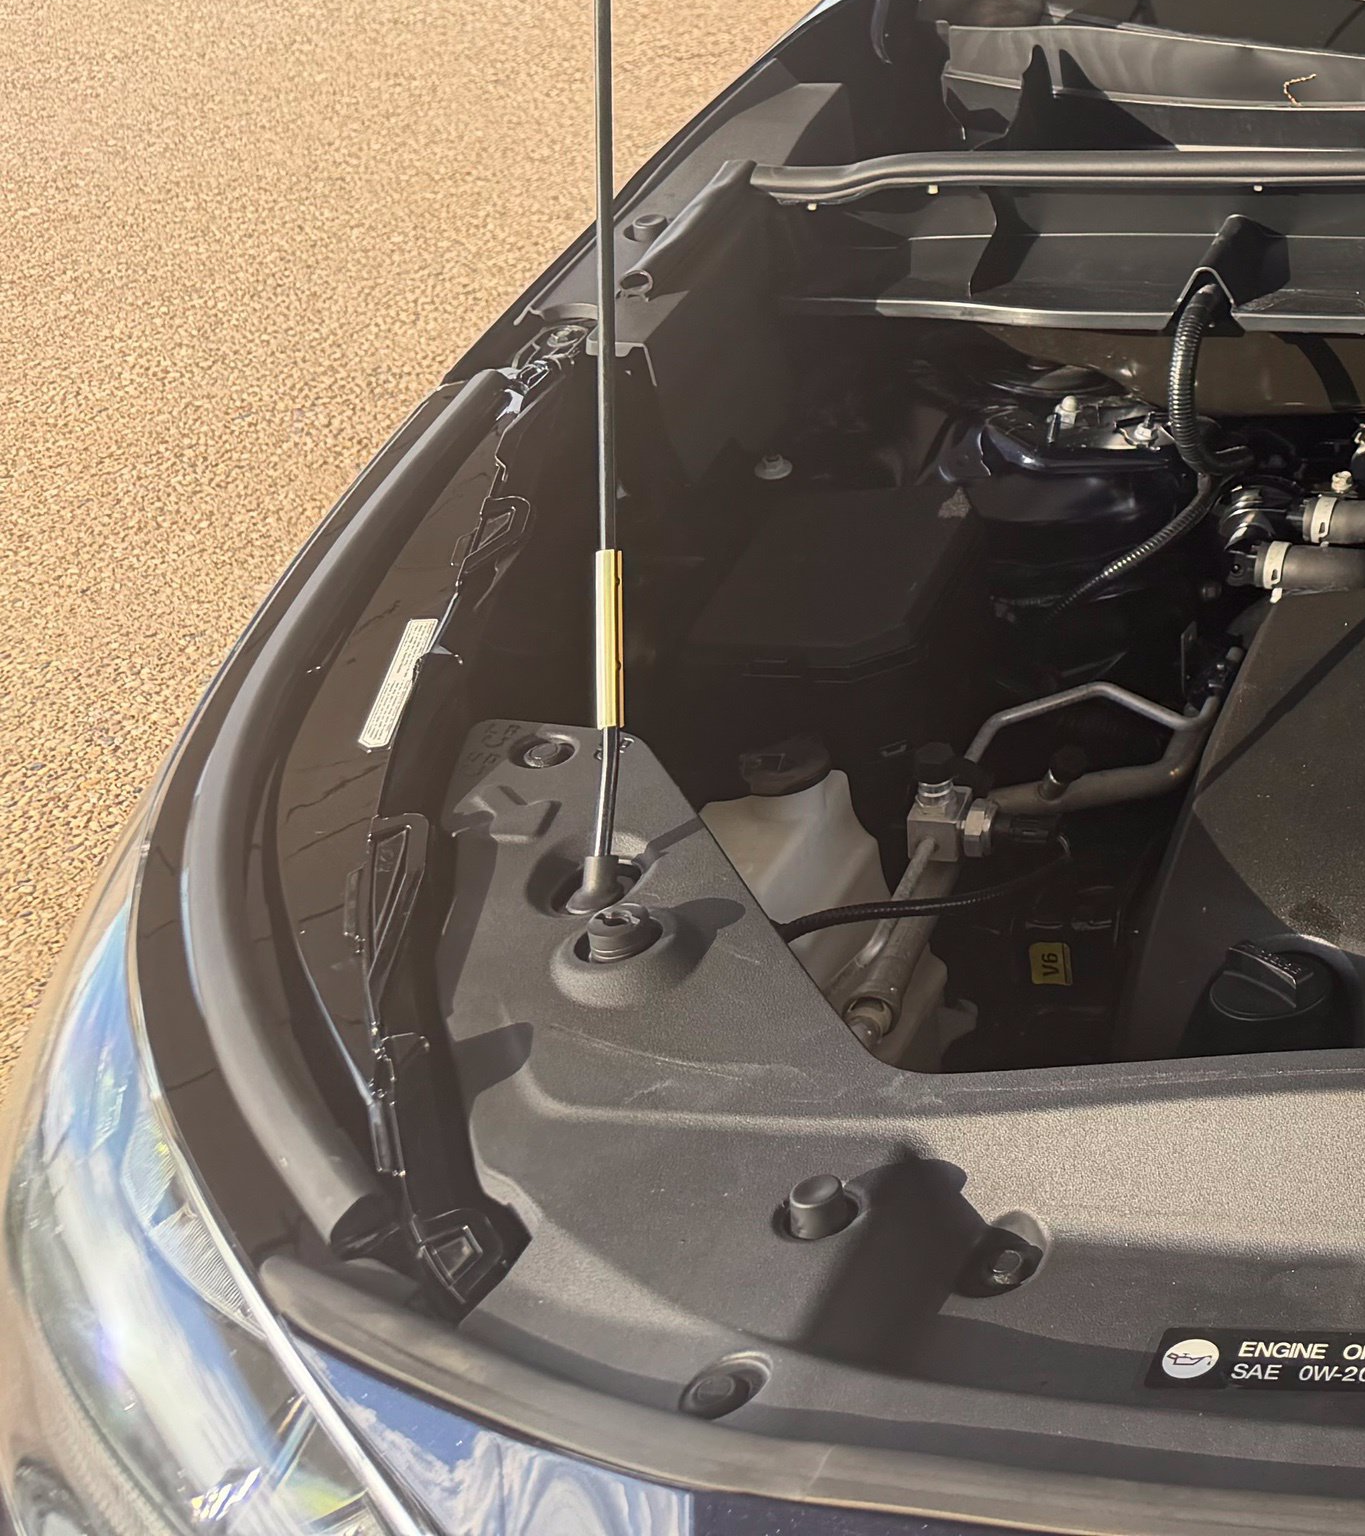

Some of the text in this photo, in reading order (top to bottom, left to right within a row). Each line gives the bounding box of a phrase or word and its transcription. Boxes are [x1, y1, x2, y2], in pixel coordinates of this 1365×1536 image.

[1041, 952, 1059, 977] V6
[1238, 1341, 1329, 1360] ENGINE
[1230, 1363, 1282, 1381] SAE
